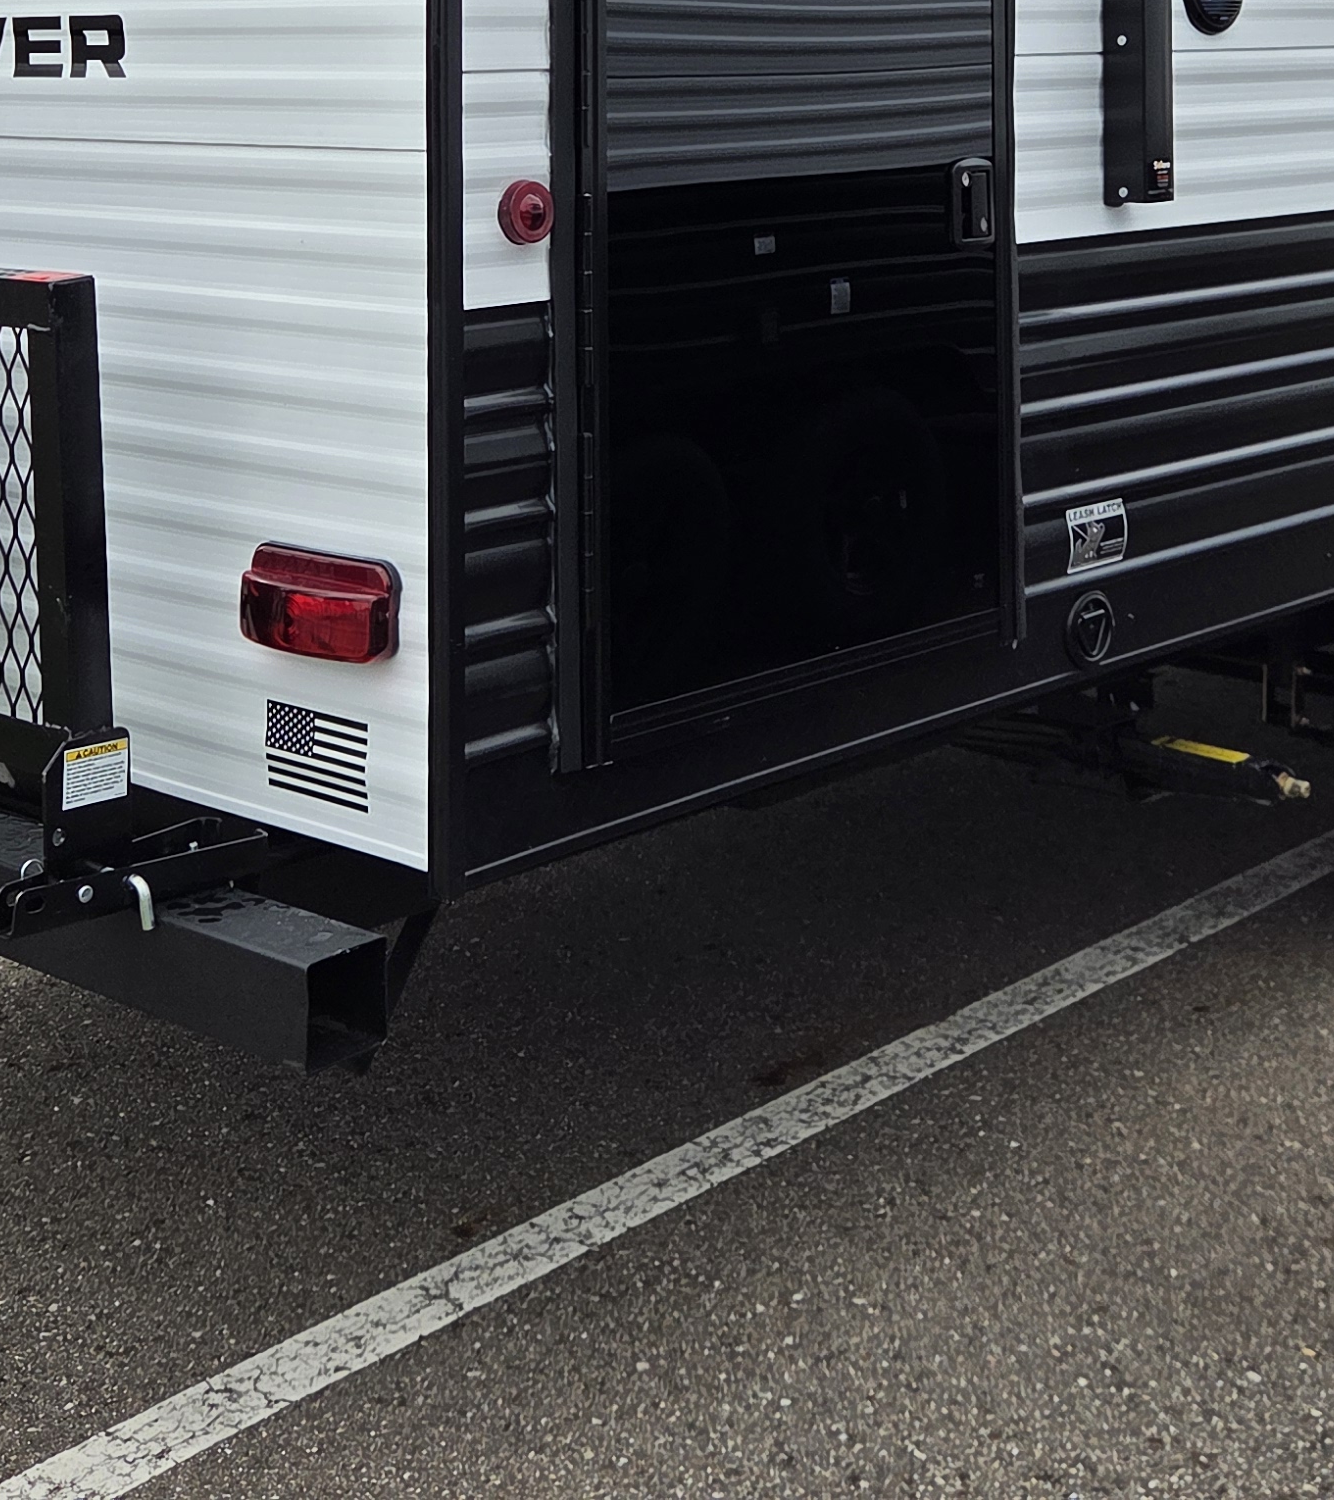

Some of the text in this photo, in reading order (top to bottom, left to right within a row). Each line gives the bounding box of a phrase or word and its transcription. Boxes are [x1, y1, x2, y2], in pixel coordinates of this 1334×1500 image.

[1068, 502, 1122, 522] LEASH LATCH
[83, 742, 119, 757] CAUTION
